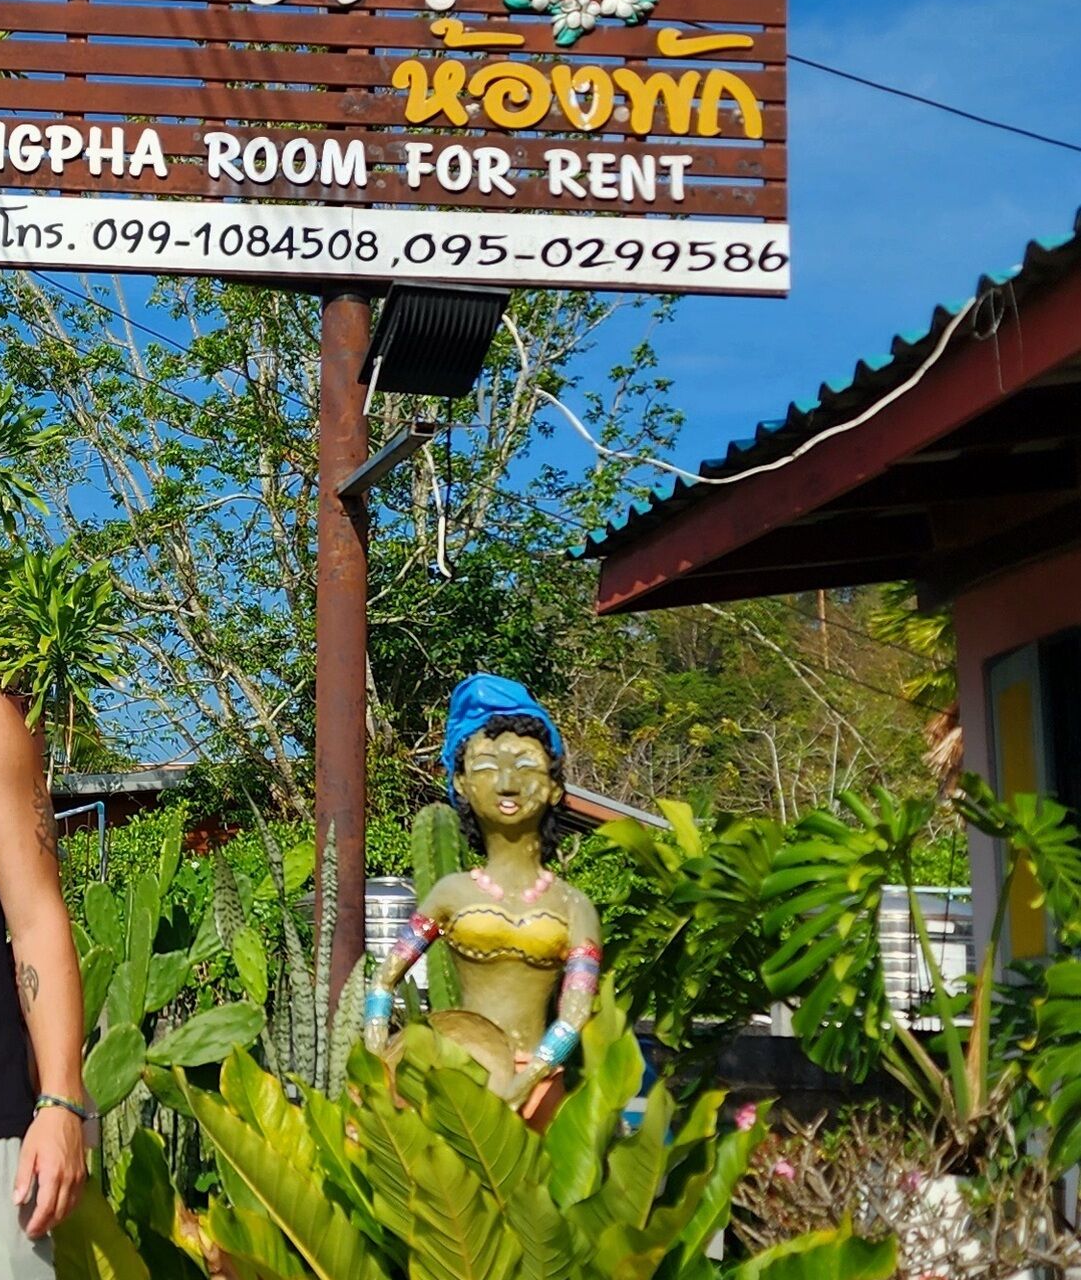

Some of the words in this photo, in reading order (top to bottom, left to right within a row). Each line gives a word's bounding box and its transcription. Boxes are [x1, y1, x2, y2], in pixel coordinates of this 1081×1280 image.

[391, 17, 763, 140] ห้องพัก
[203, 131, 368, 188] ROOM
[404, 141, 517, 197] FOR
[543, 147, 693, 203] RENT
